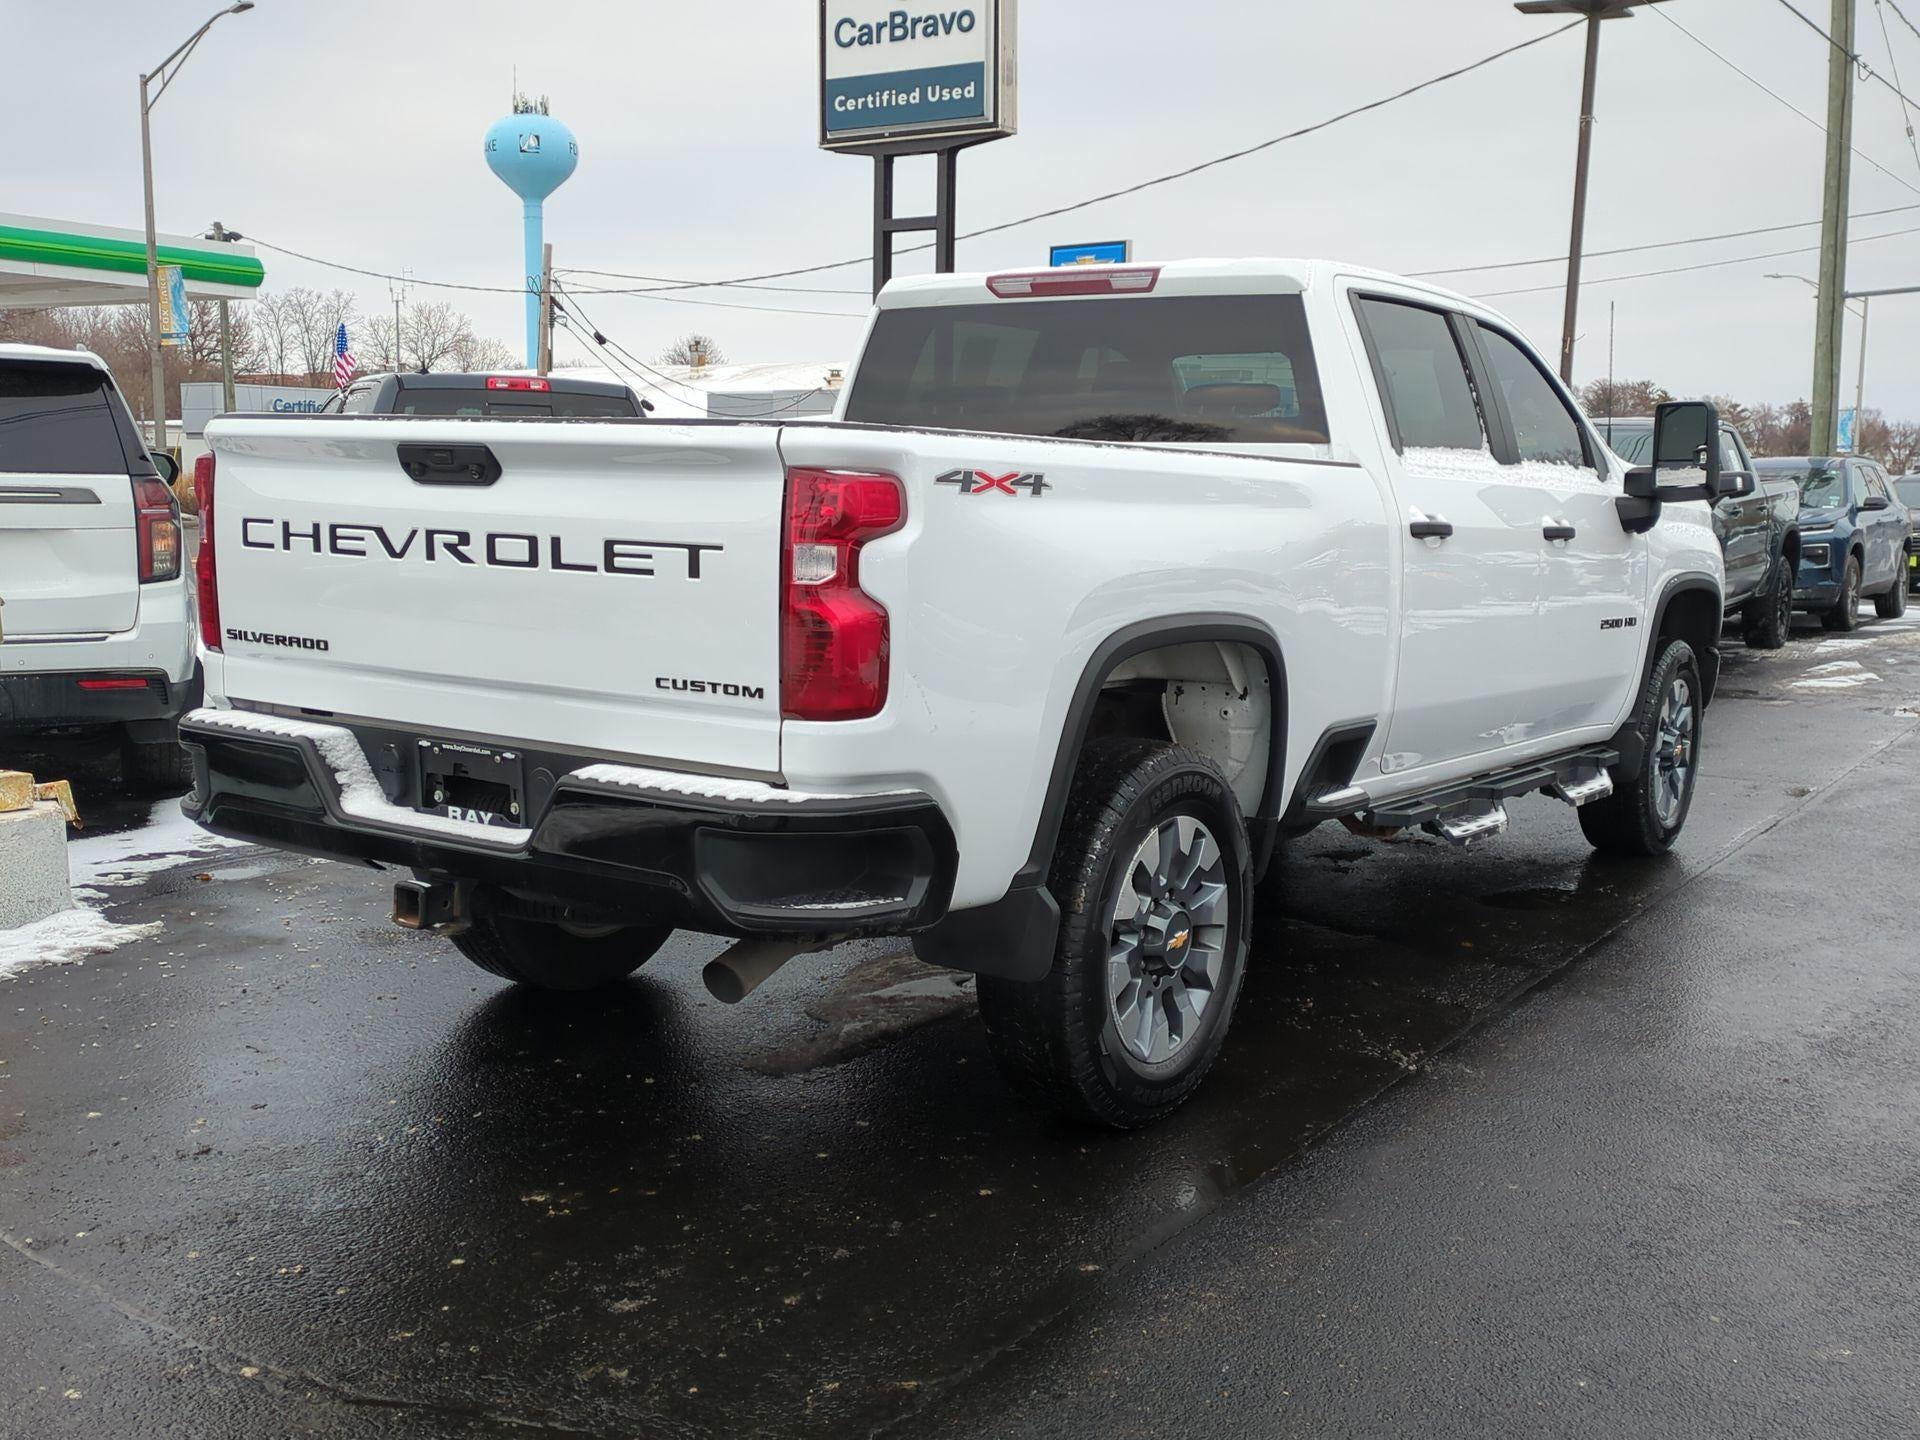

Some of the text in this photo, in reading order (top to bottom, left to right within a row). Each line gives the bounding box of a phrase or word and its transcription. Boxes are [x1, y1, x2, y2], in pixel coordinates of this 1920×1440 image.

[834, 9, 976, 48] CarBravo
[834, 81, 975, 112] Certified Used
[161, 309, 170, 331] FOX
[242, 518, 724, 579] CHEVROLET
[1600, 617, 1637, 630] 2500 HD
[226, 628, 329, 651] SILVERADO
[655, 677, 764, 699] CUSTOM
[447, 805, 493, 825] RAY
